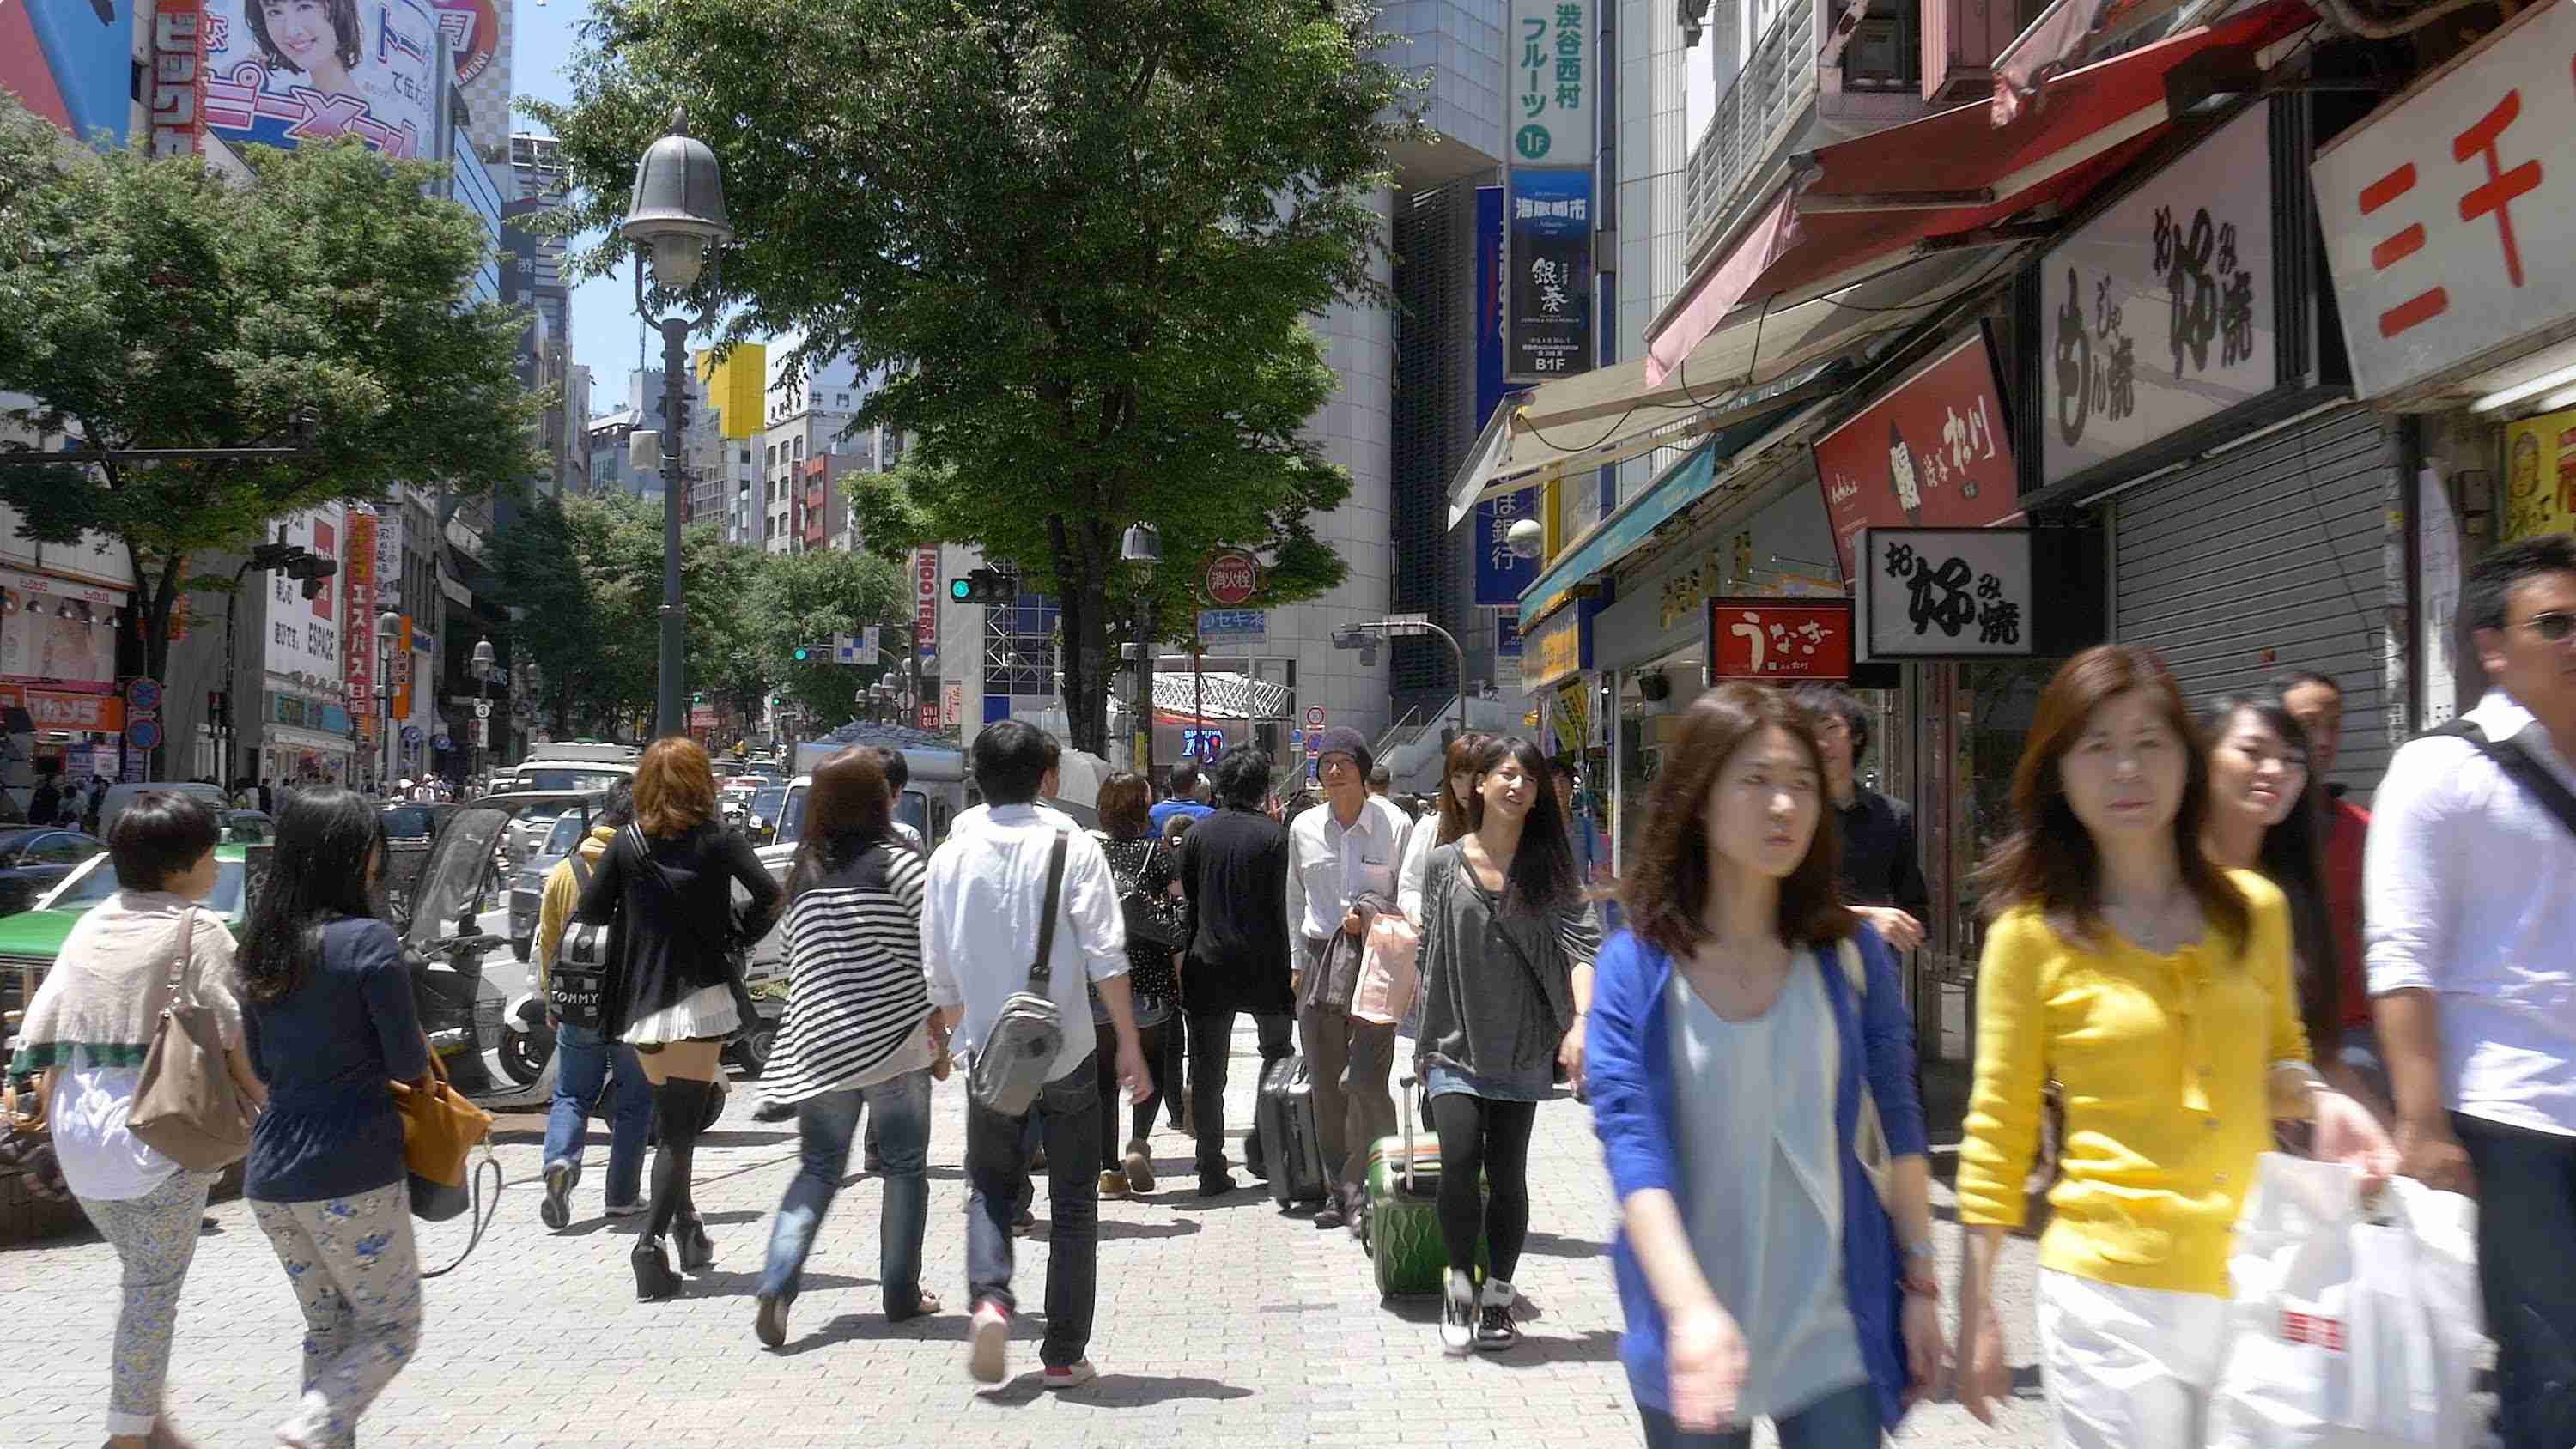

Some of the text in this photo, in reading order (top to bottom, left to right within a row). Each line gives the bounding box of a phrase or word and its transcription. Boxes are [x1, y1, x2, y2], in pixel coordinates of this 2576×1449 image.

[1555, 3, 1582, 109] 渋谷西村
[1521, 19, 1547, 118] フルーツ
[1525, 132, 1544, 151] 1F
[2359, 60, 2576, 339] 三千
[1535, 358, 1565, 371] B1F
[1212, 570, 1252, 591] 消火栓
[919, 554, 936, 644] HOOTERS
[1885, 542, 2020, 646] お好み焼
[1731, 611, 1834, 673] うなぎ
[923, 706, 939, 716] UNI
[922, 717, 939, 727] QLO
[1184, 730, 1224, 739] SHUYA
[550, 991, 598, 1004] TOMMY
